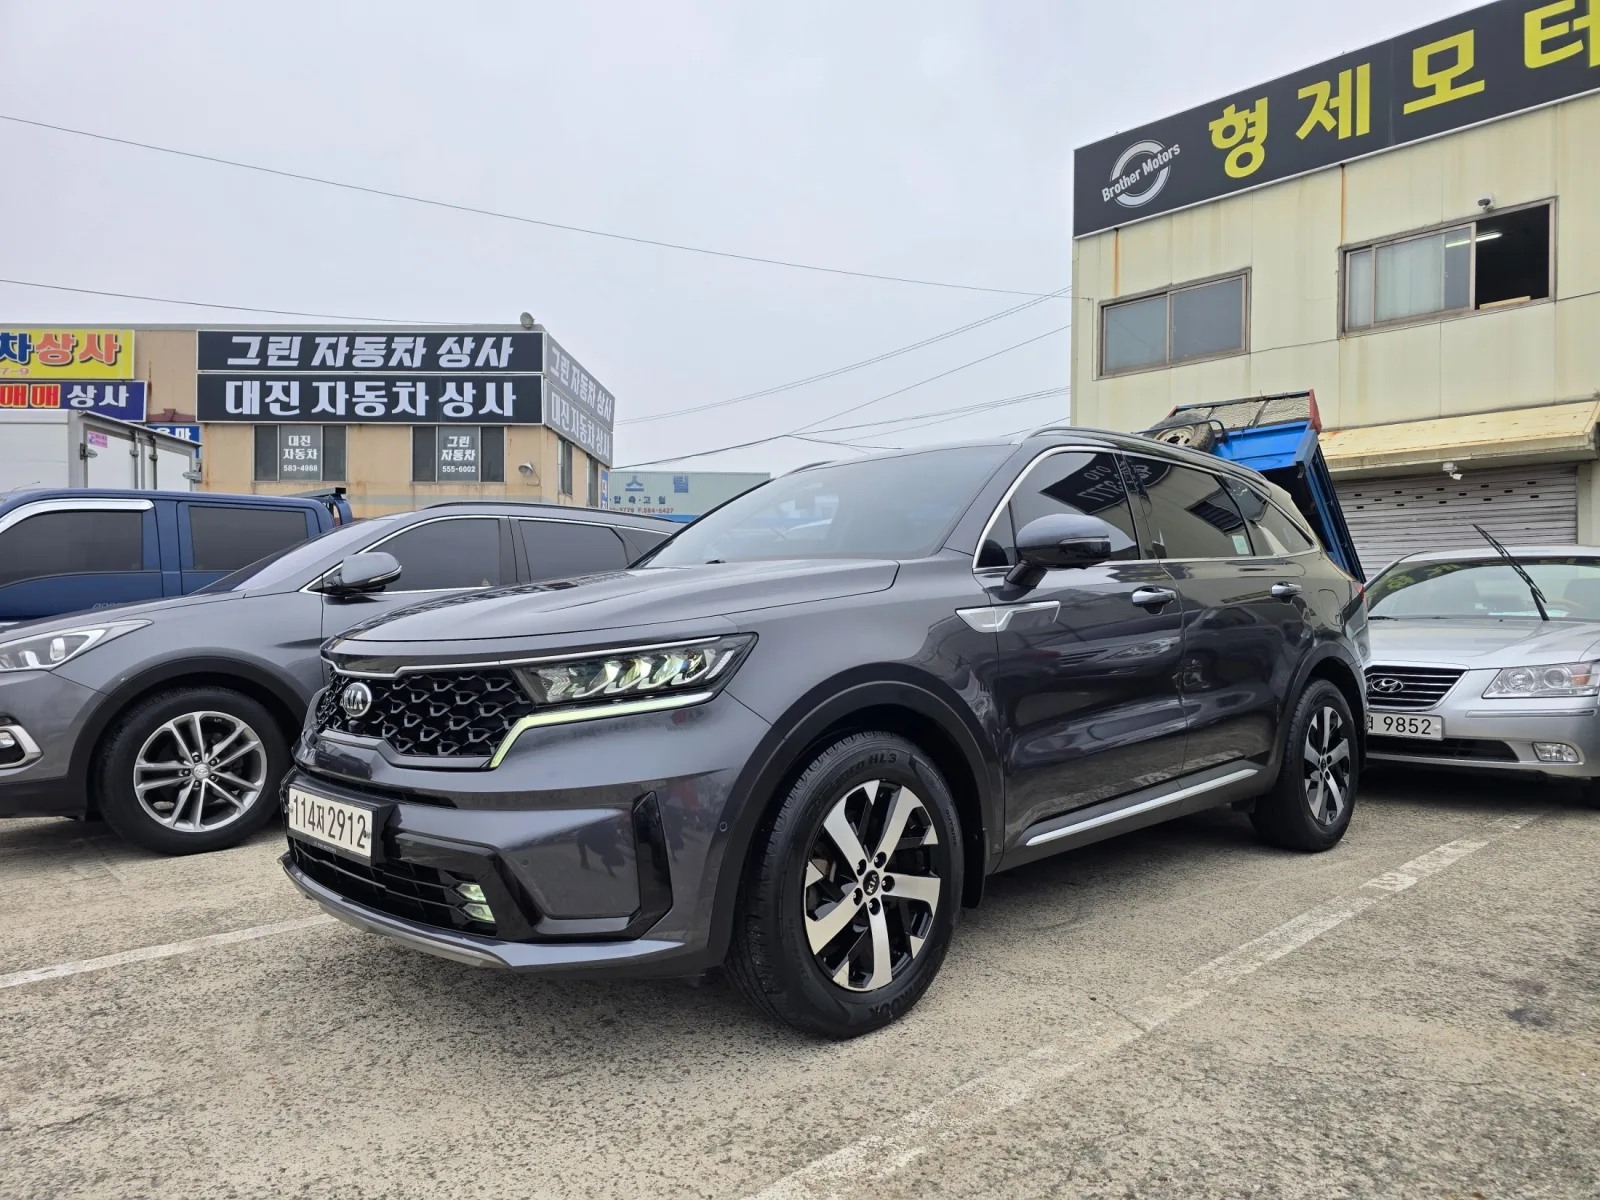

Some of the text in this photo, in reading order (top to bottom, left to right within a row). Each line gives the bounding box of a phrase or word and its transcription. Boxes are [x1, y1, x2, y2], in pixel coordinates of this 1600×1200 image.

[1101, 144, 1181, 202] Brother Motors
[226, 336, 513, 368] 그린 자동차 상사
[550, 346, 612, 422] 그린 자동차 상사
[67, 385, 130, 408] 상사
[224, 380, 517, 418] 대진 자동차 상사
[551, 391, 610, 460] 대진 자동차 상사
[288, 435, 311, 447] 대진
[447, 436, 470, 448] 그린
[283, 448, 318, 460] 자동차
[441, 449, 476, 461] 자동차
[283, 464, 318, 472] 583-4988
[442, 465, 476, 473] 555-6002
[343, 689, 363, 710] KIA
[1383, 716, 1431, 735] 9852
[294, 795, 367, 849] 114저2912
[867, 873, 878, 894] KIA
